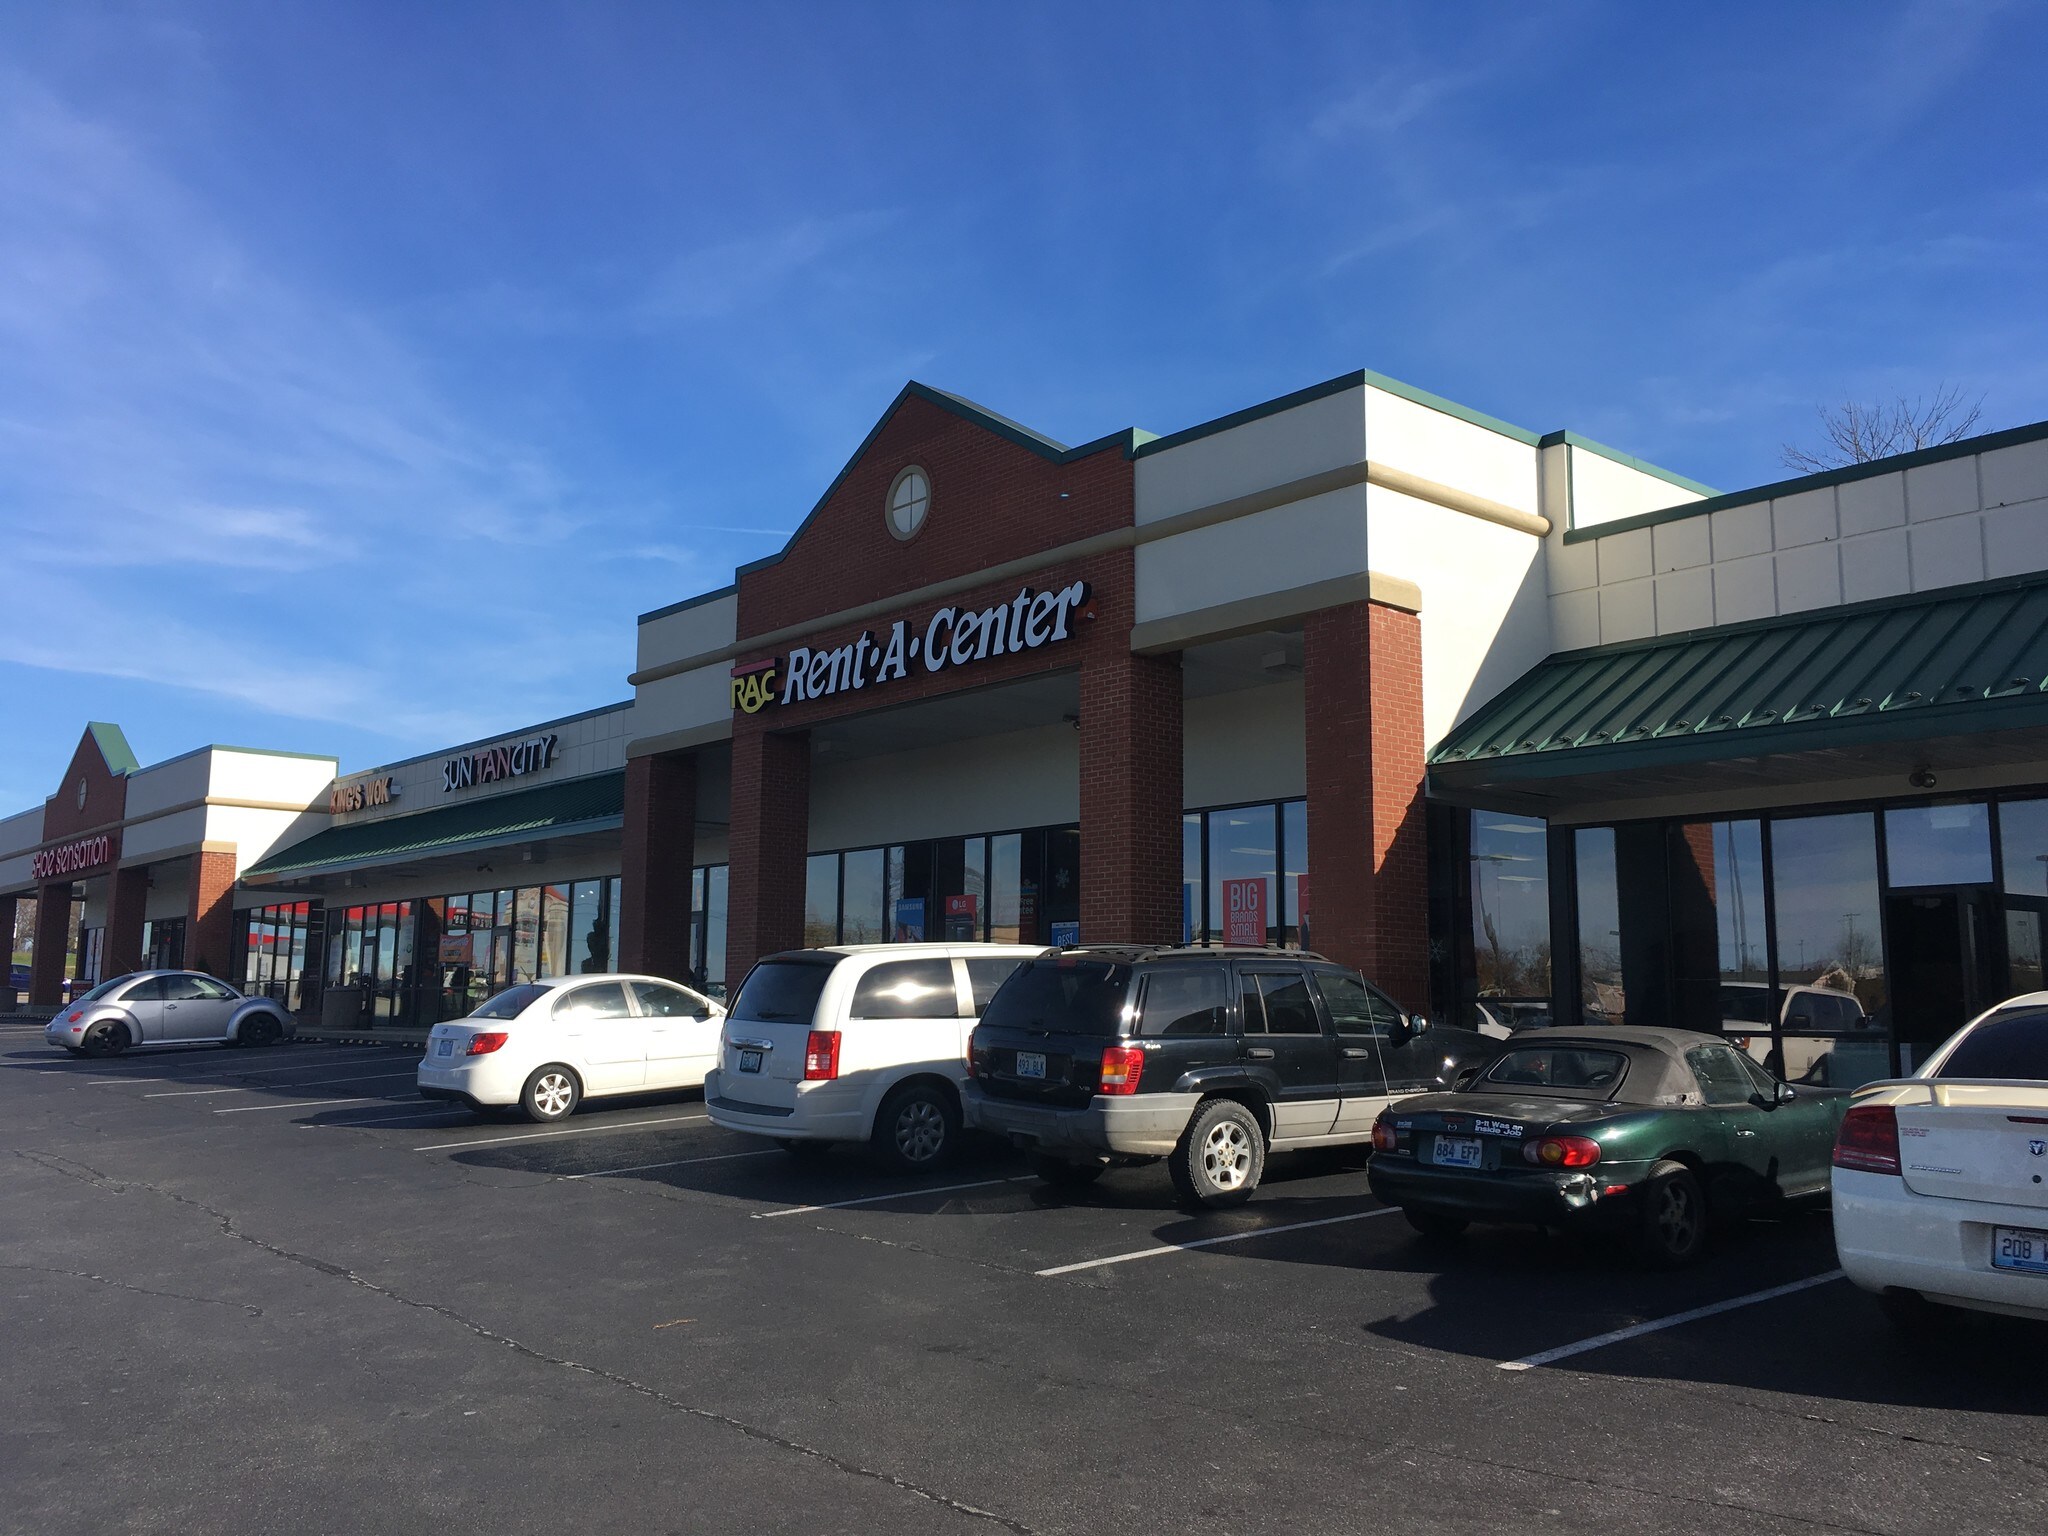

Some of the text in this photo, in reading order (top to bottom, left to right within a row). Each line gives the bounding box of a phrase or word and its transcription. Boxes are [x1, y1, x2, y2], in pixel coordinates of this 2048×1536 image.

[731, 670, 776, 714] RAC
[366, 777, 390, 806] WOK
[1230, 882, 1258, 912] BIG
[1230, 911, 1258, 923] BRANDS
[1230, 923, 1258, 936] SMALL
[1018, 1059, 1030, 1070] 493
[1474, 1126, 1522, 1137] Inside Job
[1491, 1121, 1511, 1130] Was
[1511, 1124, 1524, 1132] an
[1436, 1143, 1480, 1160] 884 EFP
[2002, 1238, 2032, 1260] 208
